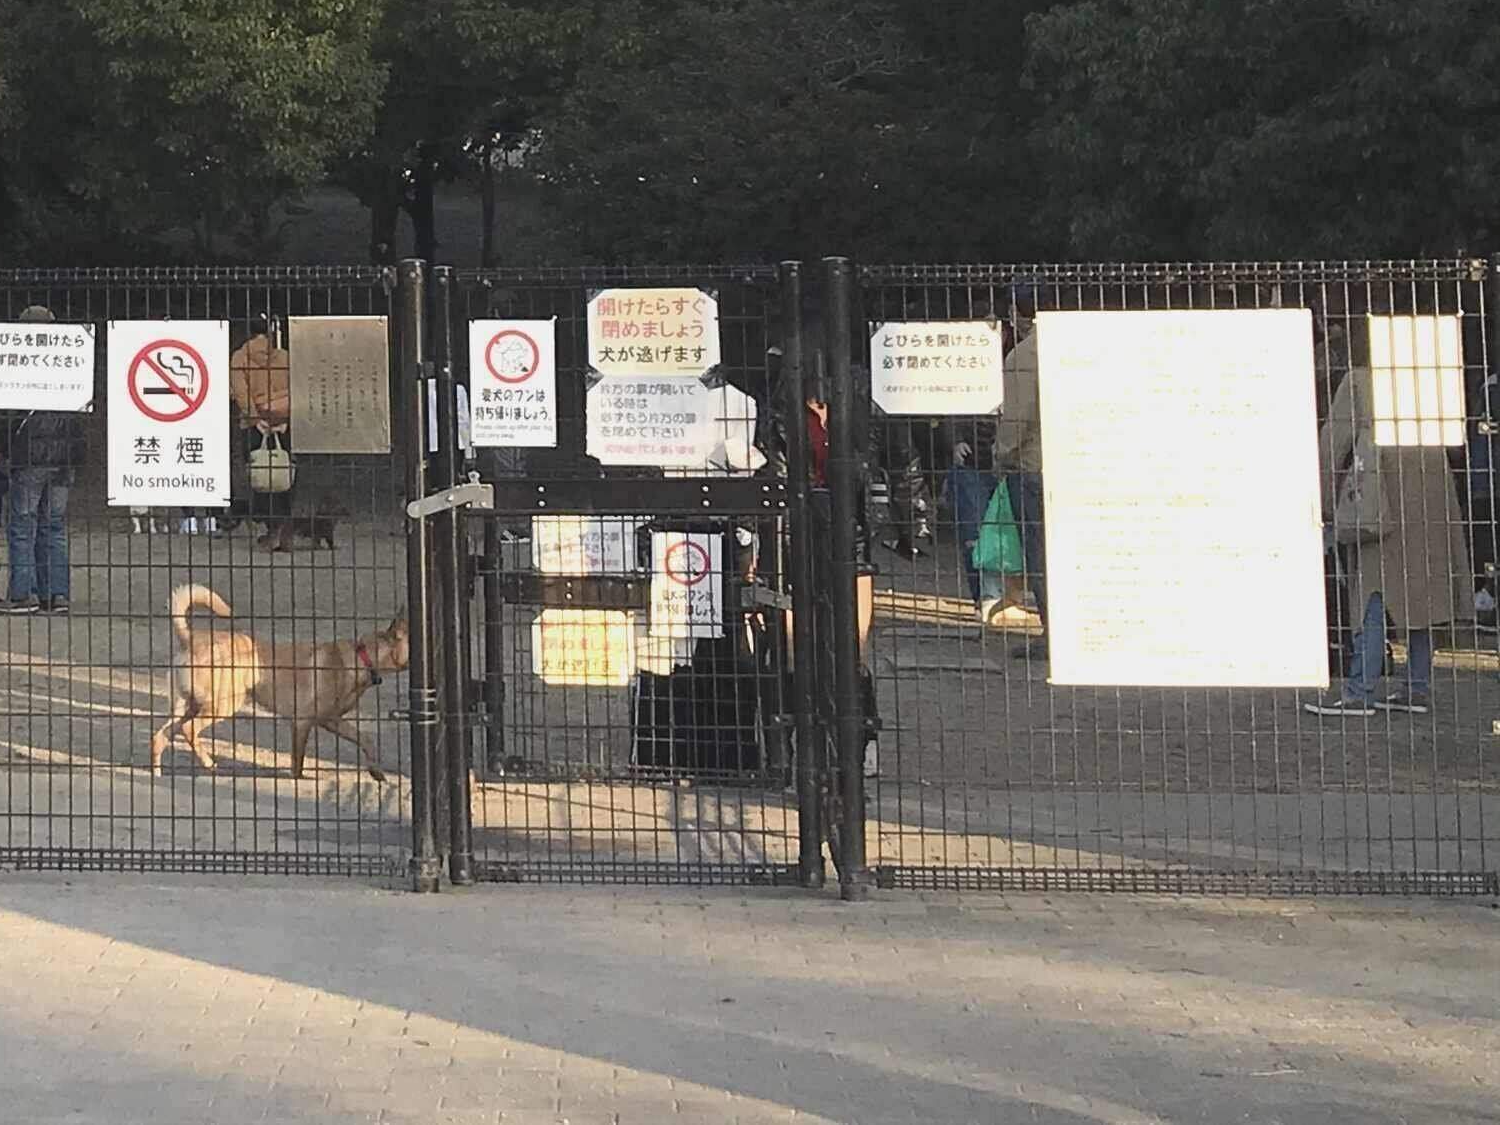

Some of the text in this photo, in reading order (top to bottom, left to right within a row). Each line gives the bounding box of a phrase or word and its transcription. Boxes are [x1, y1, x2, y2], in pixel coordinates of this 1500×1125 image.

[597, 297, 707, 316] 開けたらすぐ
[601, 320, 705, 339] 閉めましょう
[882, 334, 991, 348] とびらを開けたら
[598, 345, 707, 364] 犬が逃げます
[882, 355, 993, 370] 必ず閉めてください
[482, 388, 546, 402] 愛犬のフンは
[133, 436, 205, 466] 禁煙
[122, 472, 215, 492] No smoking
